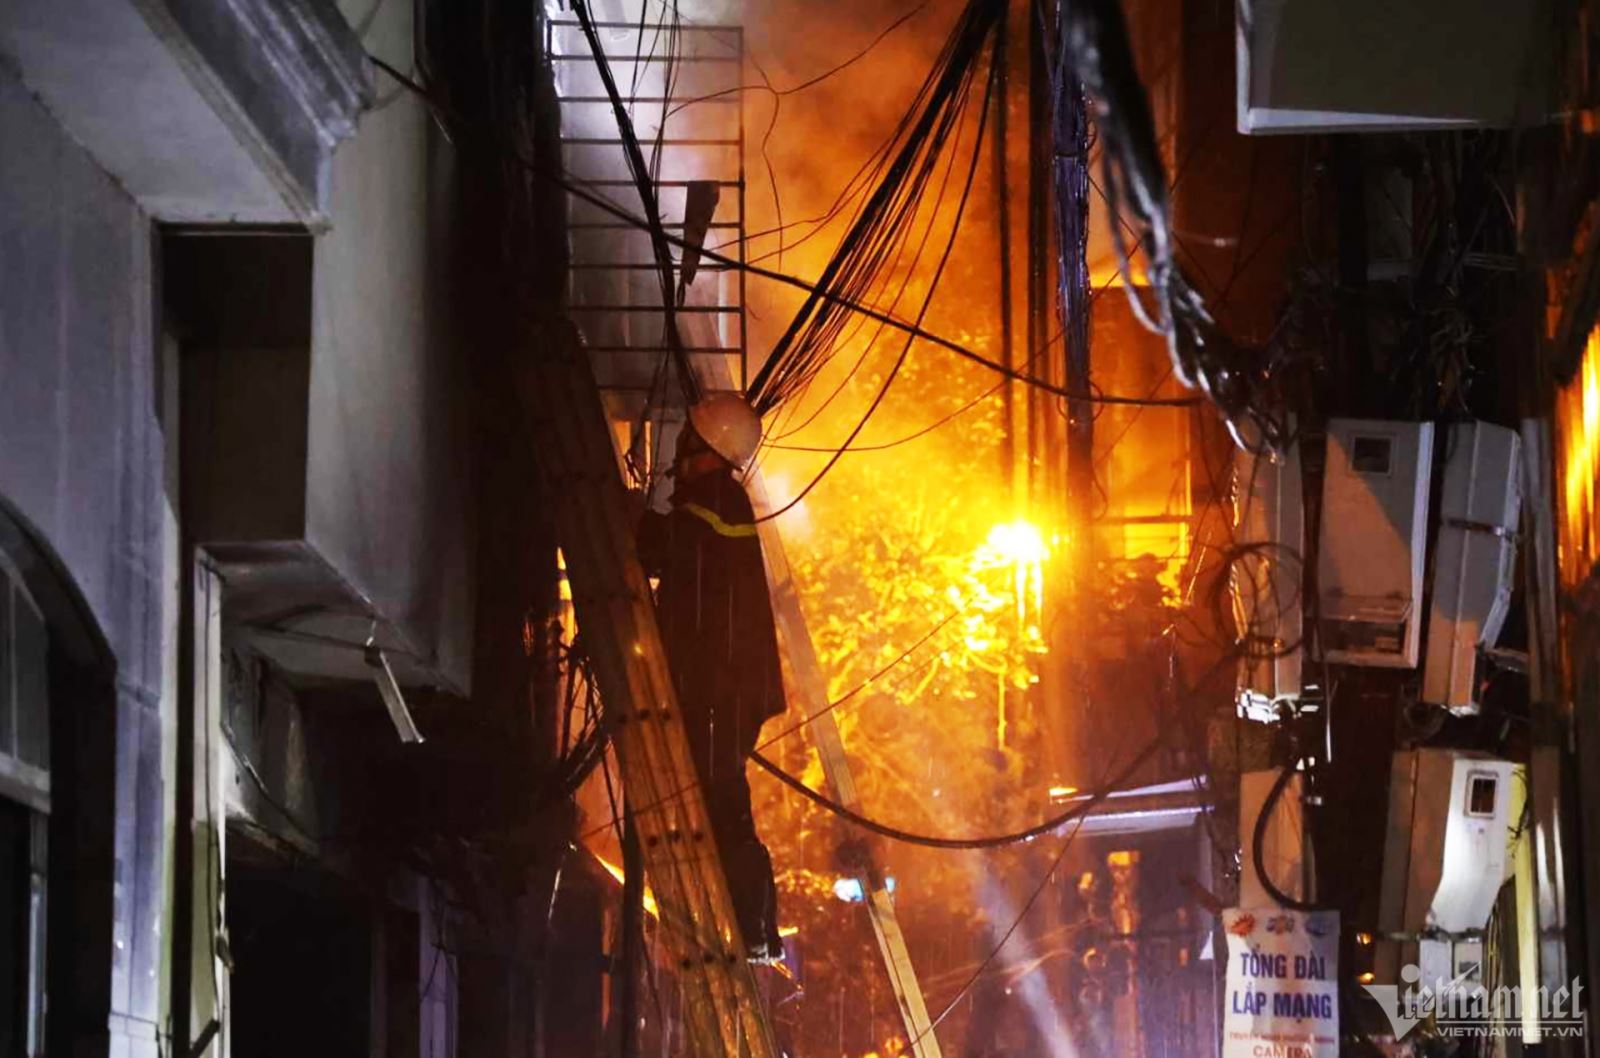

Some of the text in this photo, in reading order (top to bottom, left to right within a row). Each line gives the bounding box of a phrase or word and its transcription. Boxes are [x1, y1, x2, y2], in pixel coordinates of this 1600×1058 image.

[1240, 943, 1326, 981] TỔNG ĐÀI
[1273, 992, 1332, 1023] MẠNG
